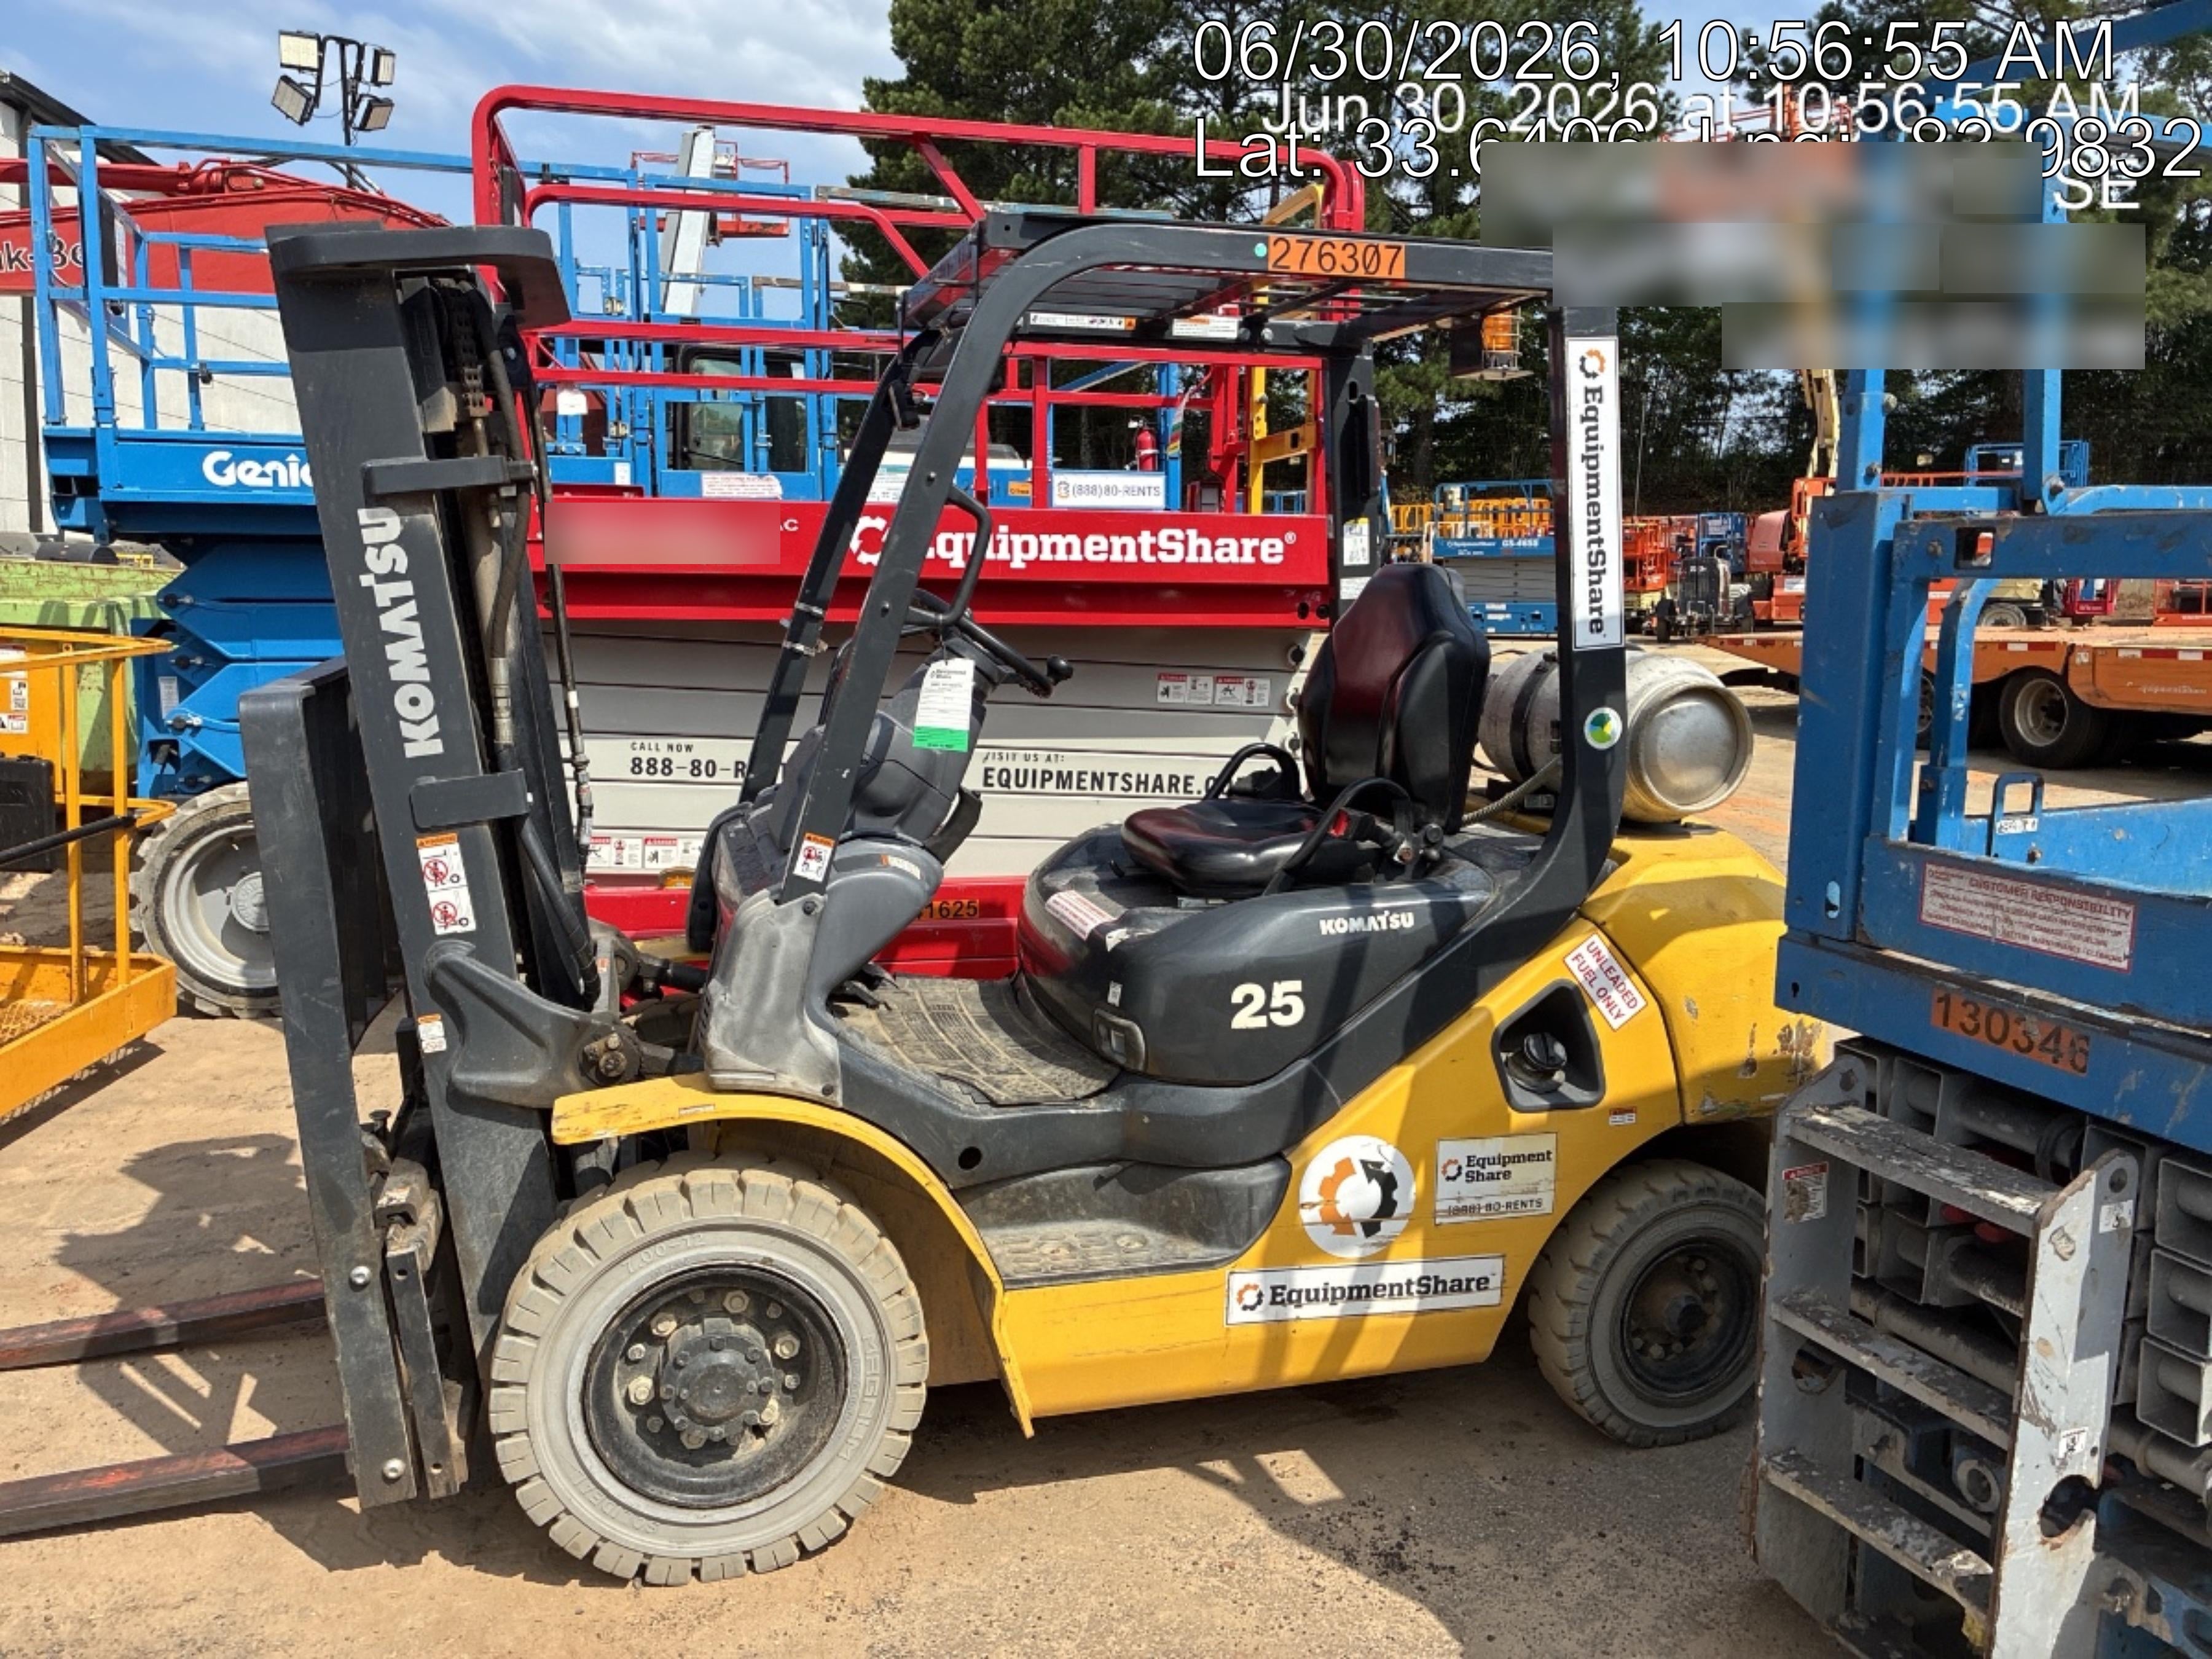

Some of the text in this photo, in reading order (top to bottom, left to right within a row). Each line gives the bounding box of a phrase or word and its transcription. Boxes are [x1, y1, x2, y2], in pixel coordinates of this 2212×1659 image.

[1272, 237, 1403, 276] 276307
[1580, 385, 1607, 635] EquipmentShare
[357, 507, 444, 758] KOMATSU
[630, 742, 694, 753] CALL NOW
[1024, 753, 1039, 763] US
[1045, 753, 1065, 764] AT:
[917, 900, 978, 919] 1625
[1319, 909, 1415, 935] KOMATSU
[1571, 952, 1625, 1020] FUEL ONLY
[1586, 941, 1638, 1010] UNLEADED
[1231, 979, 1306, 1030] 25
[1465, 1150, 1553, 1169] Equipment
[1465, 1169, 1512, 1183] Share
[1269, 1274, 1490, 1308] EquipmentShare
